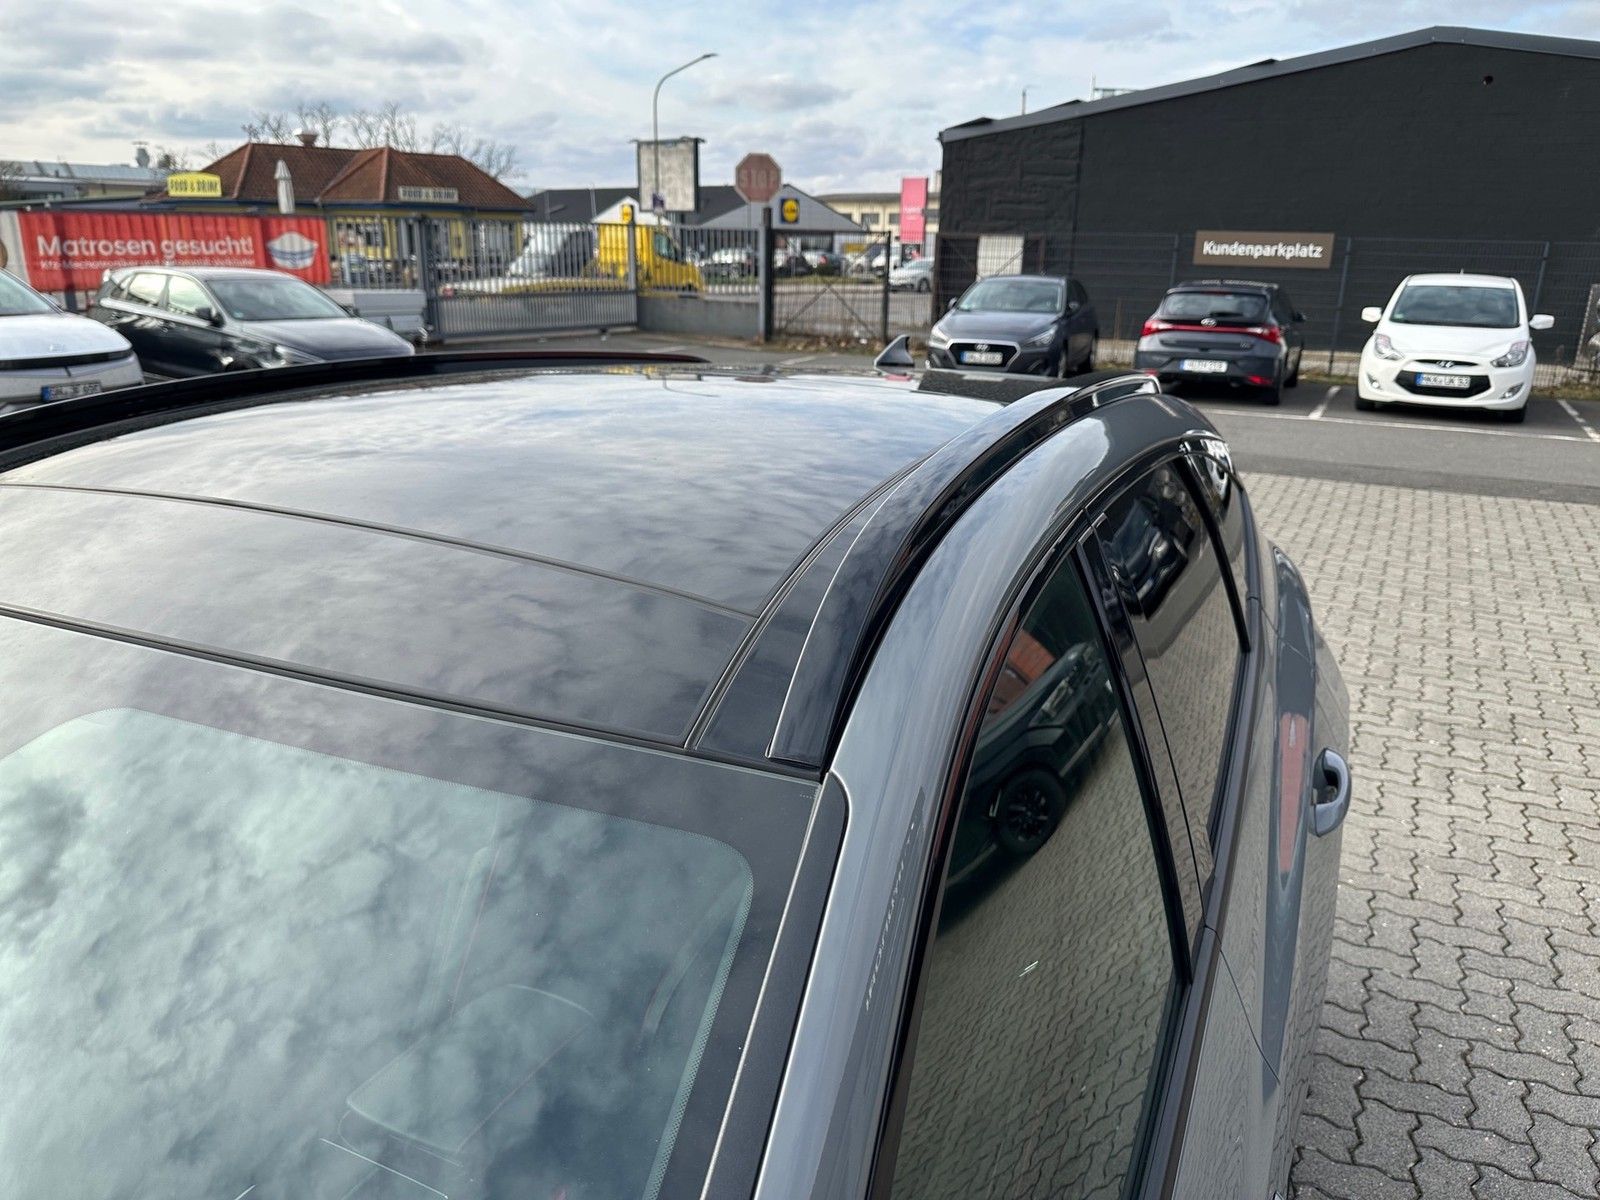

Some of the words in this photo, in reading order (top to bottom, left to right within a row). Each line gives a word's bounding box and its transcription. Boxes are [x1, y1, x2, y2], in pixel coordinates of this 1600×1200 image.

[36, 235, 157, 256] Matrosen
[160, 236, 254, 260] gesucht!
[1202, 240, 1323, 260] Kundenparkplatz
